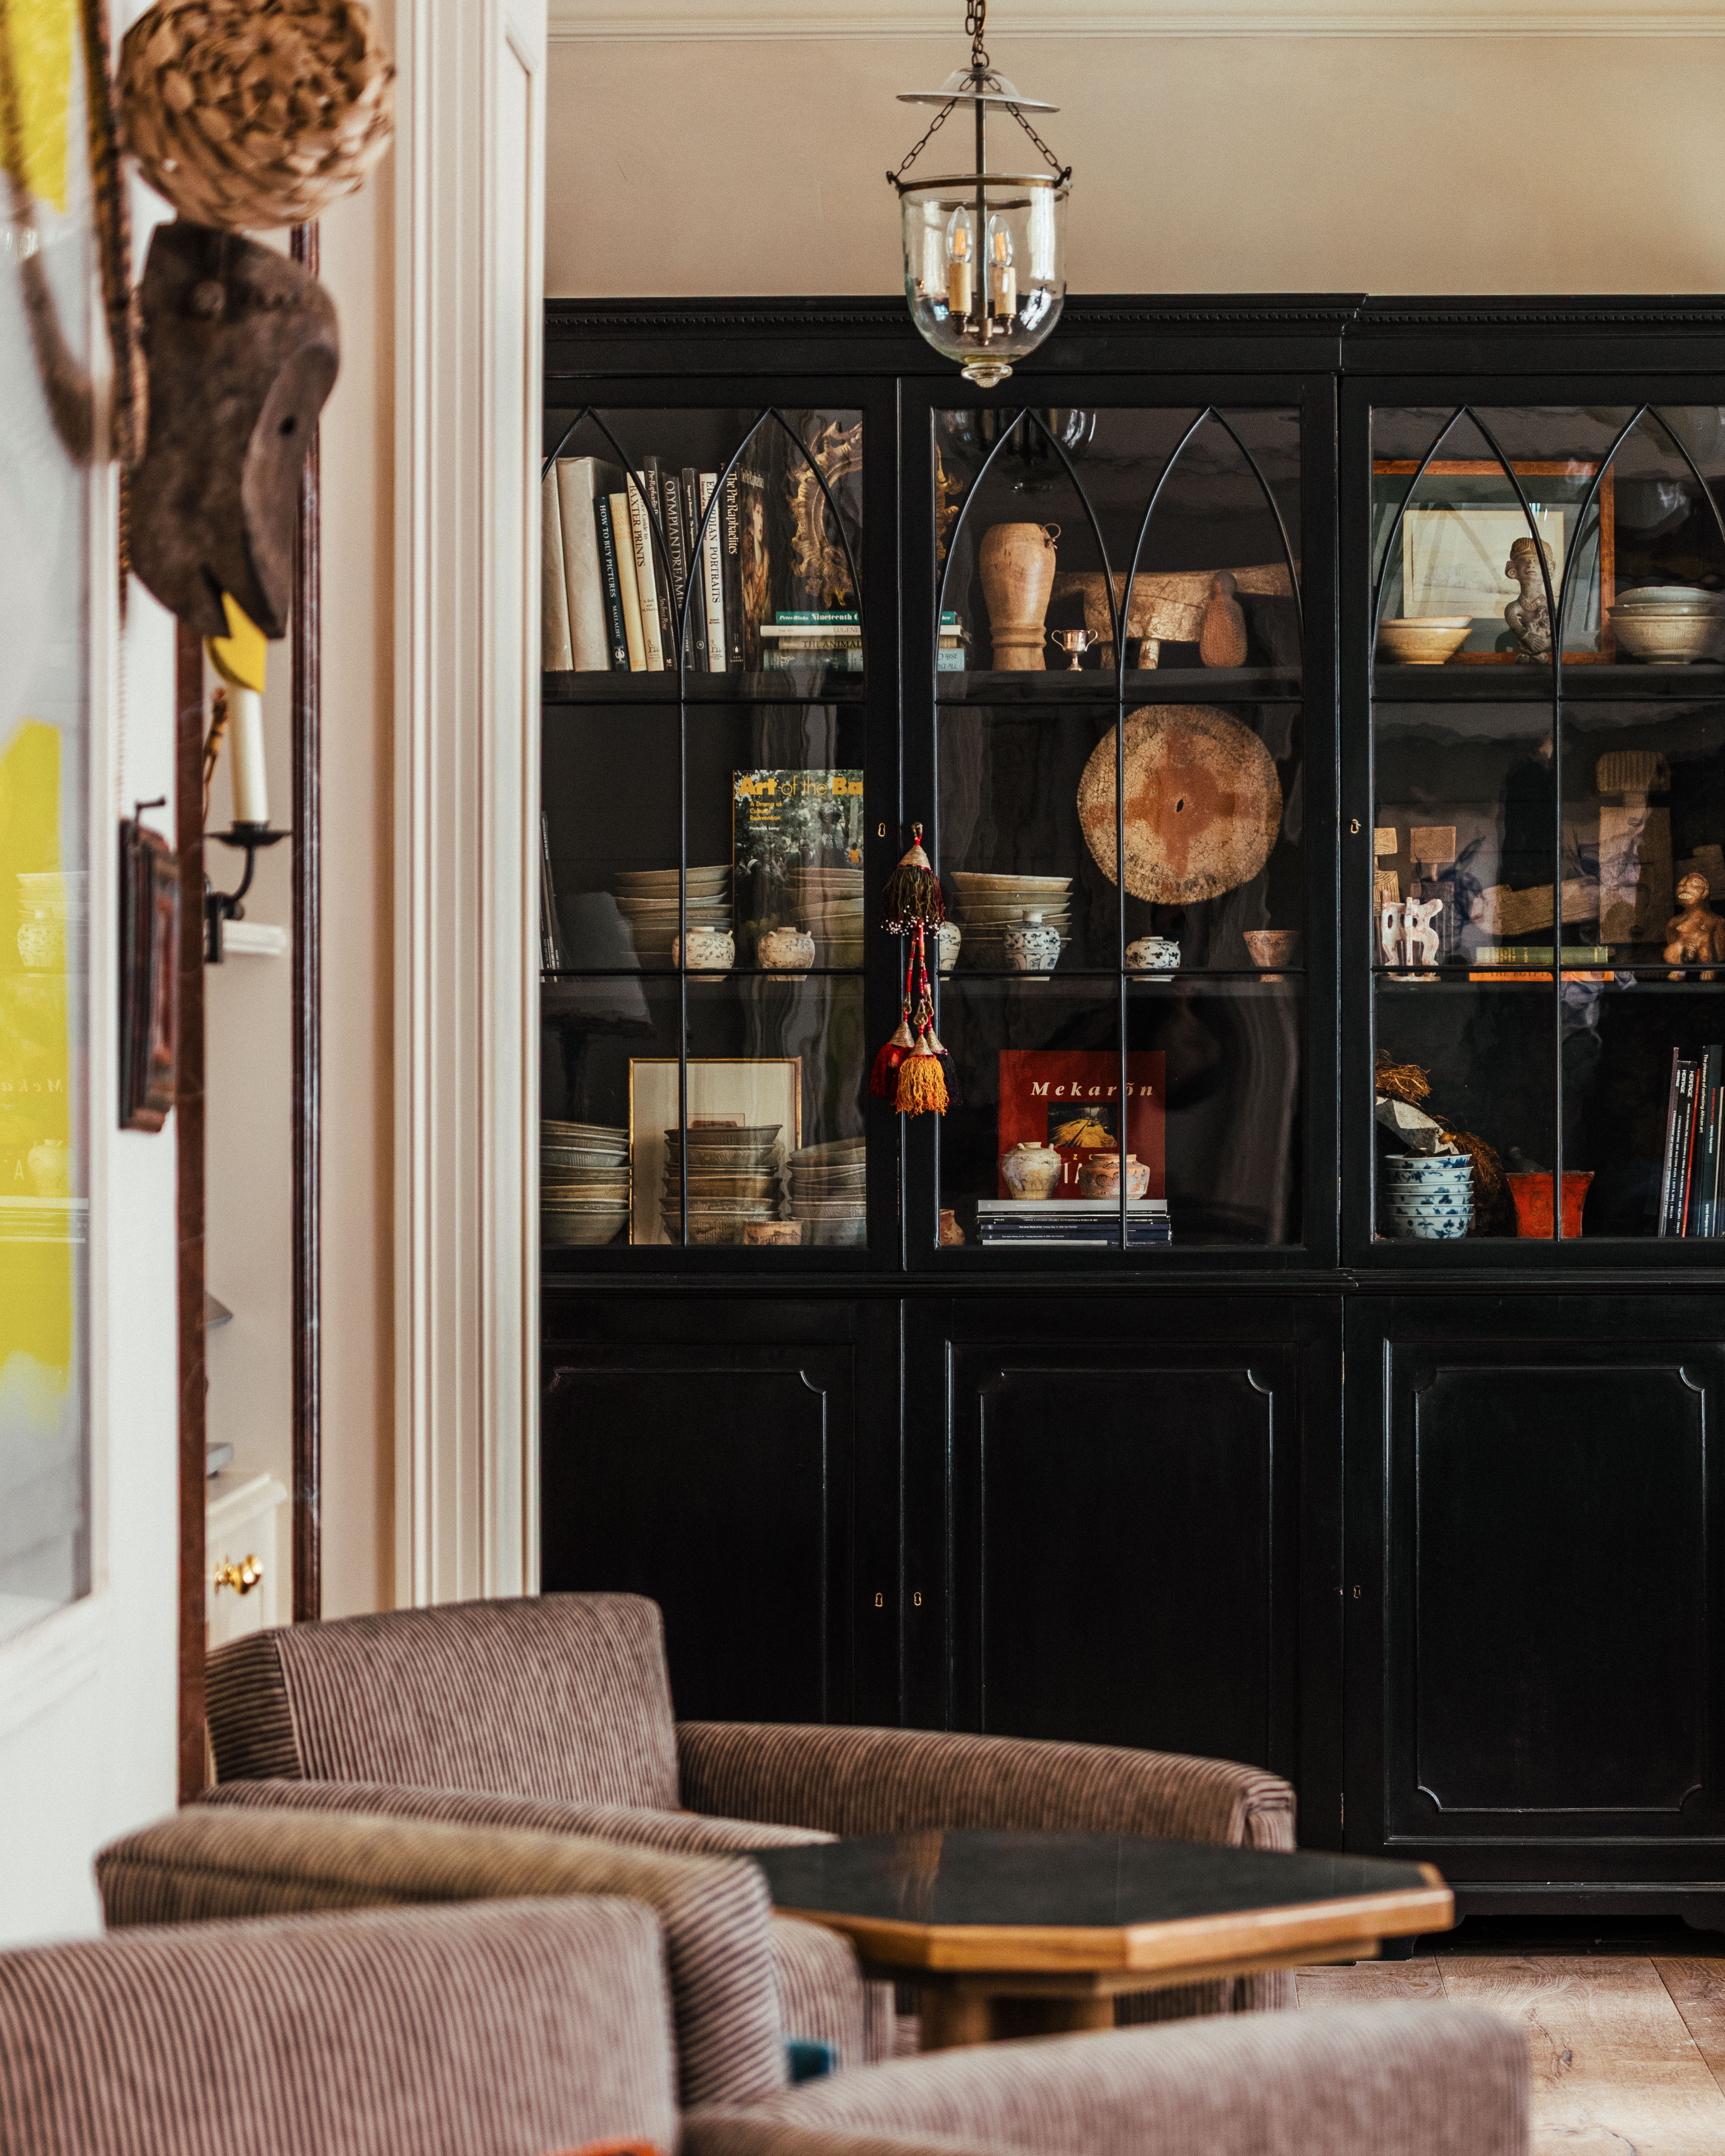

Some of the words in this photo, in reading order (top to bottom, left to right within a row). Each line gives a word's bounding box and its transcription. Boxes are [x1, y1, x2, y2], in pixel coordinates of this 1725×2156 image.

[648, 470, 658, 509] Pre-Raphaelite
[726, 471, 737, 489] The
[600, 505, 608, 525] HOW
[629, 485, 641, 526] BAXTER
[665, 481, 681, 546] OLYMPIAN
[706, 481, 717, 541] EDRDIAN
[602, 528, 609, 538] TO
[634, 530, 645, 567] PRINTS
[606, 559, 616, 597] PICTURES
[710, 547, 721, 603] PORTRAITS
[612, 605, 621, 638] MALLALIEU
[738, 777, 777, 795] Art
[781, 775, 798, 795] of
[803, 775, 828, 795] the
[1030, 1082, 1153, 1096] Mekarõn
